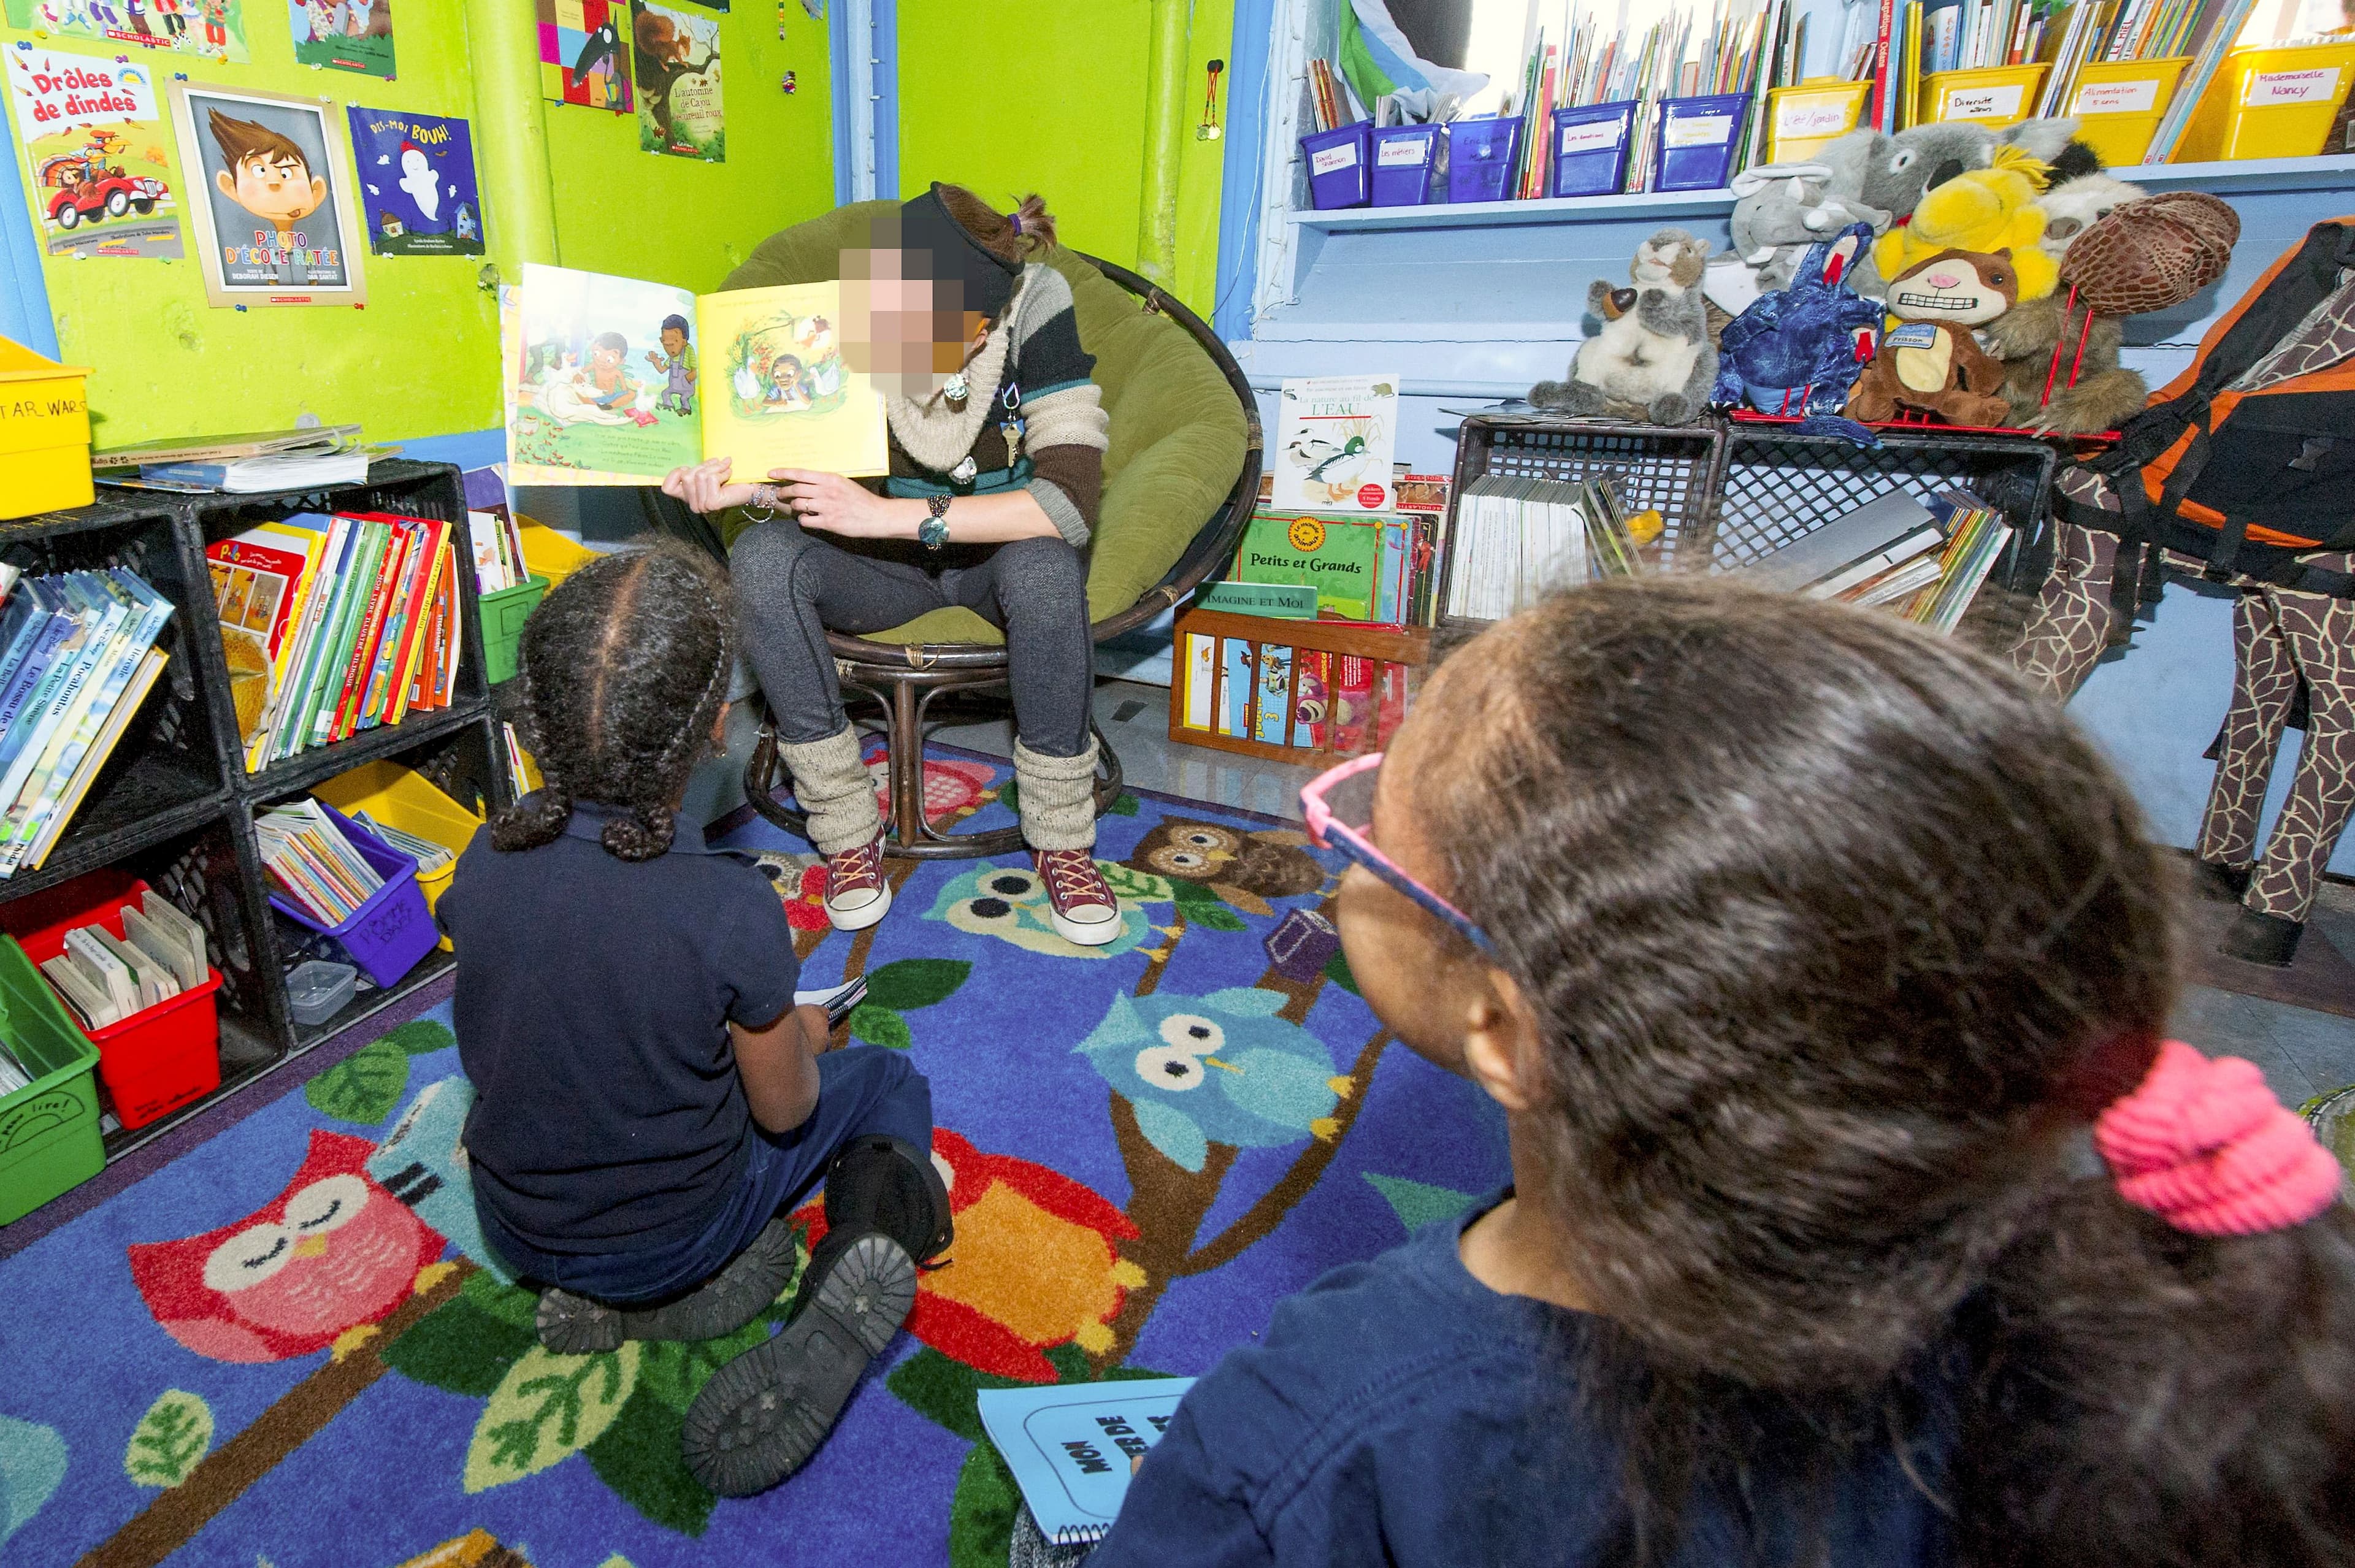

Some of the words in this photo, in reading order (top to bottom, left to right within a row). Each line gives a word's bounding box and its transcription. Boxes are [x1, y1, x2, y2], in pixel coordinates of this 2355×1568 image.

[116, 32, 170, 45] SCHOLASTIC
[2110, 44, 2122, 55] LE
[32, 67, 112, 94] Drôles
[2259, 71, 2325, 82] Mademoiselle
[675, 87, 713, 98] L'automne
[2085, 87, 2137, 96] Alimentation
[2271, 86, 2310, 98] Nancy
[33, 100, 61, 121] de
[65, 91, 137, 115] dindes
[681, 99, 689, 109] de
[691, 98, 711, 109] Cajou
[369, 120, 408, 134] DIS-MOI
[412, 124, 451, 144] BOUH!
[1315, 153, 1331, 163] David
[255, 230, 307, 248] PHOTO
[225, 244, 289, 265] D'ÉCOLE
[293, 247, 339, 266] RATÉE
[0, 401, 44, 419] TAR
[47, 399, 86, 416] WARS
[1312, 403, 1360, 416] L'EAU
[1300, 522, 1320, 534] monde
[1293, 534, 1319, 547] animaux
[1250, 553, 1290, 567] Petits
[1293, 559, 1307, 569] et
[1310, 558, 1363, 574] Grands
[305, 582, 312, 591] My
[375, 574, 385, 591] MON
[368, 594, 378, 614] LIVRE
[1260, 598, 1273, 606] ET
[293, 611, 303, 632] Needs
[418, 599, 431, 630] Topotip
[286, 633, 295, 651] Sleep
[435, 614, 443, 652] STEGOSAURUS
[57, 662, 70, 673] La
[118, 648, 142, 678] Hercule
[29, 666, 42, 679] Le
[9, 678, 31, 709] Bossu
[42, 673, 62, 698] Petite
[52, 661, 92, 716] Pocahontas
[0, 711, 13, 724] de
[5, 843, 25, 865] Phidal
[1095, 1415, 1136, 1436] DE
[1060, 1440, 1112, 1474] MON
